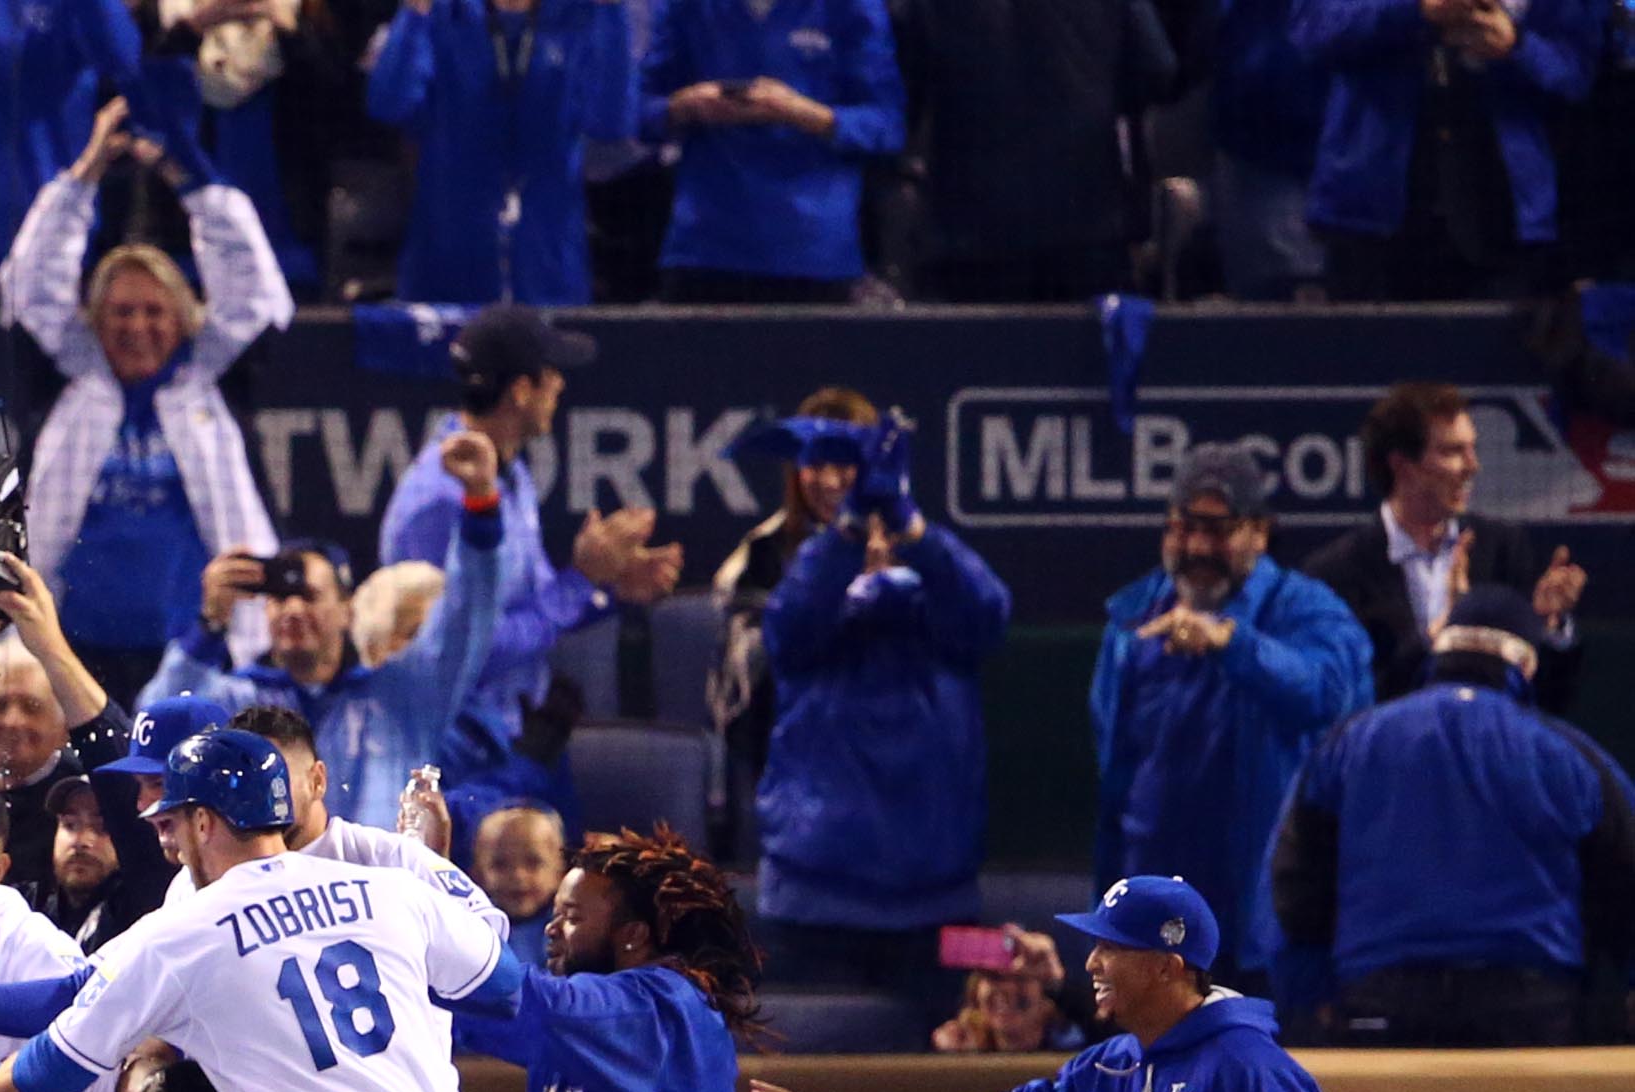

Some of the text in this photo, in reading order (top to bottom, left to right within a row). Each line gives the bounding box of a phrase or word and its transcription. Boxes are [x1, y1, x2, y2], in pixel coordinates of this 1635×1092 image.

[132, 711, 155, 747] KC
[215, 879, 374, 958] ZOBRIST
[277, 939, 396, 1072] 18
